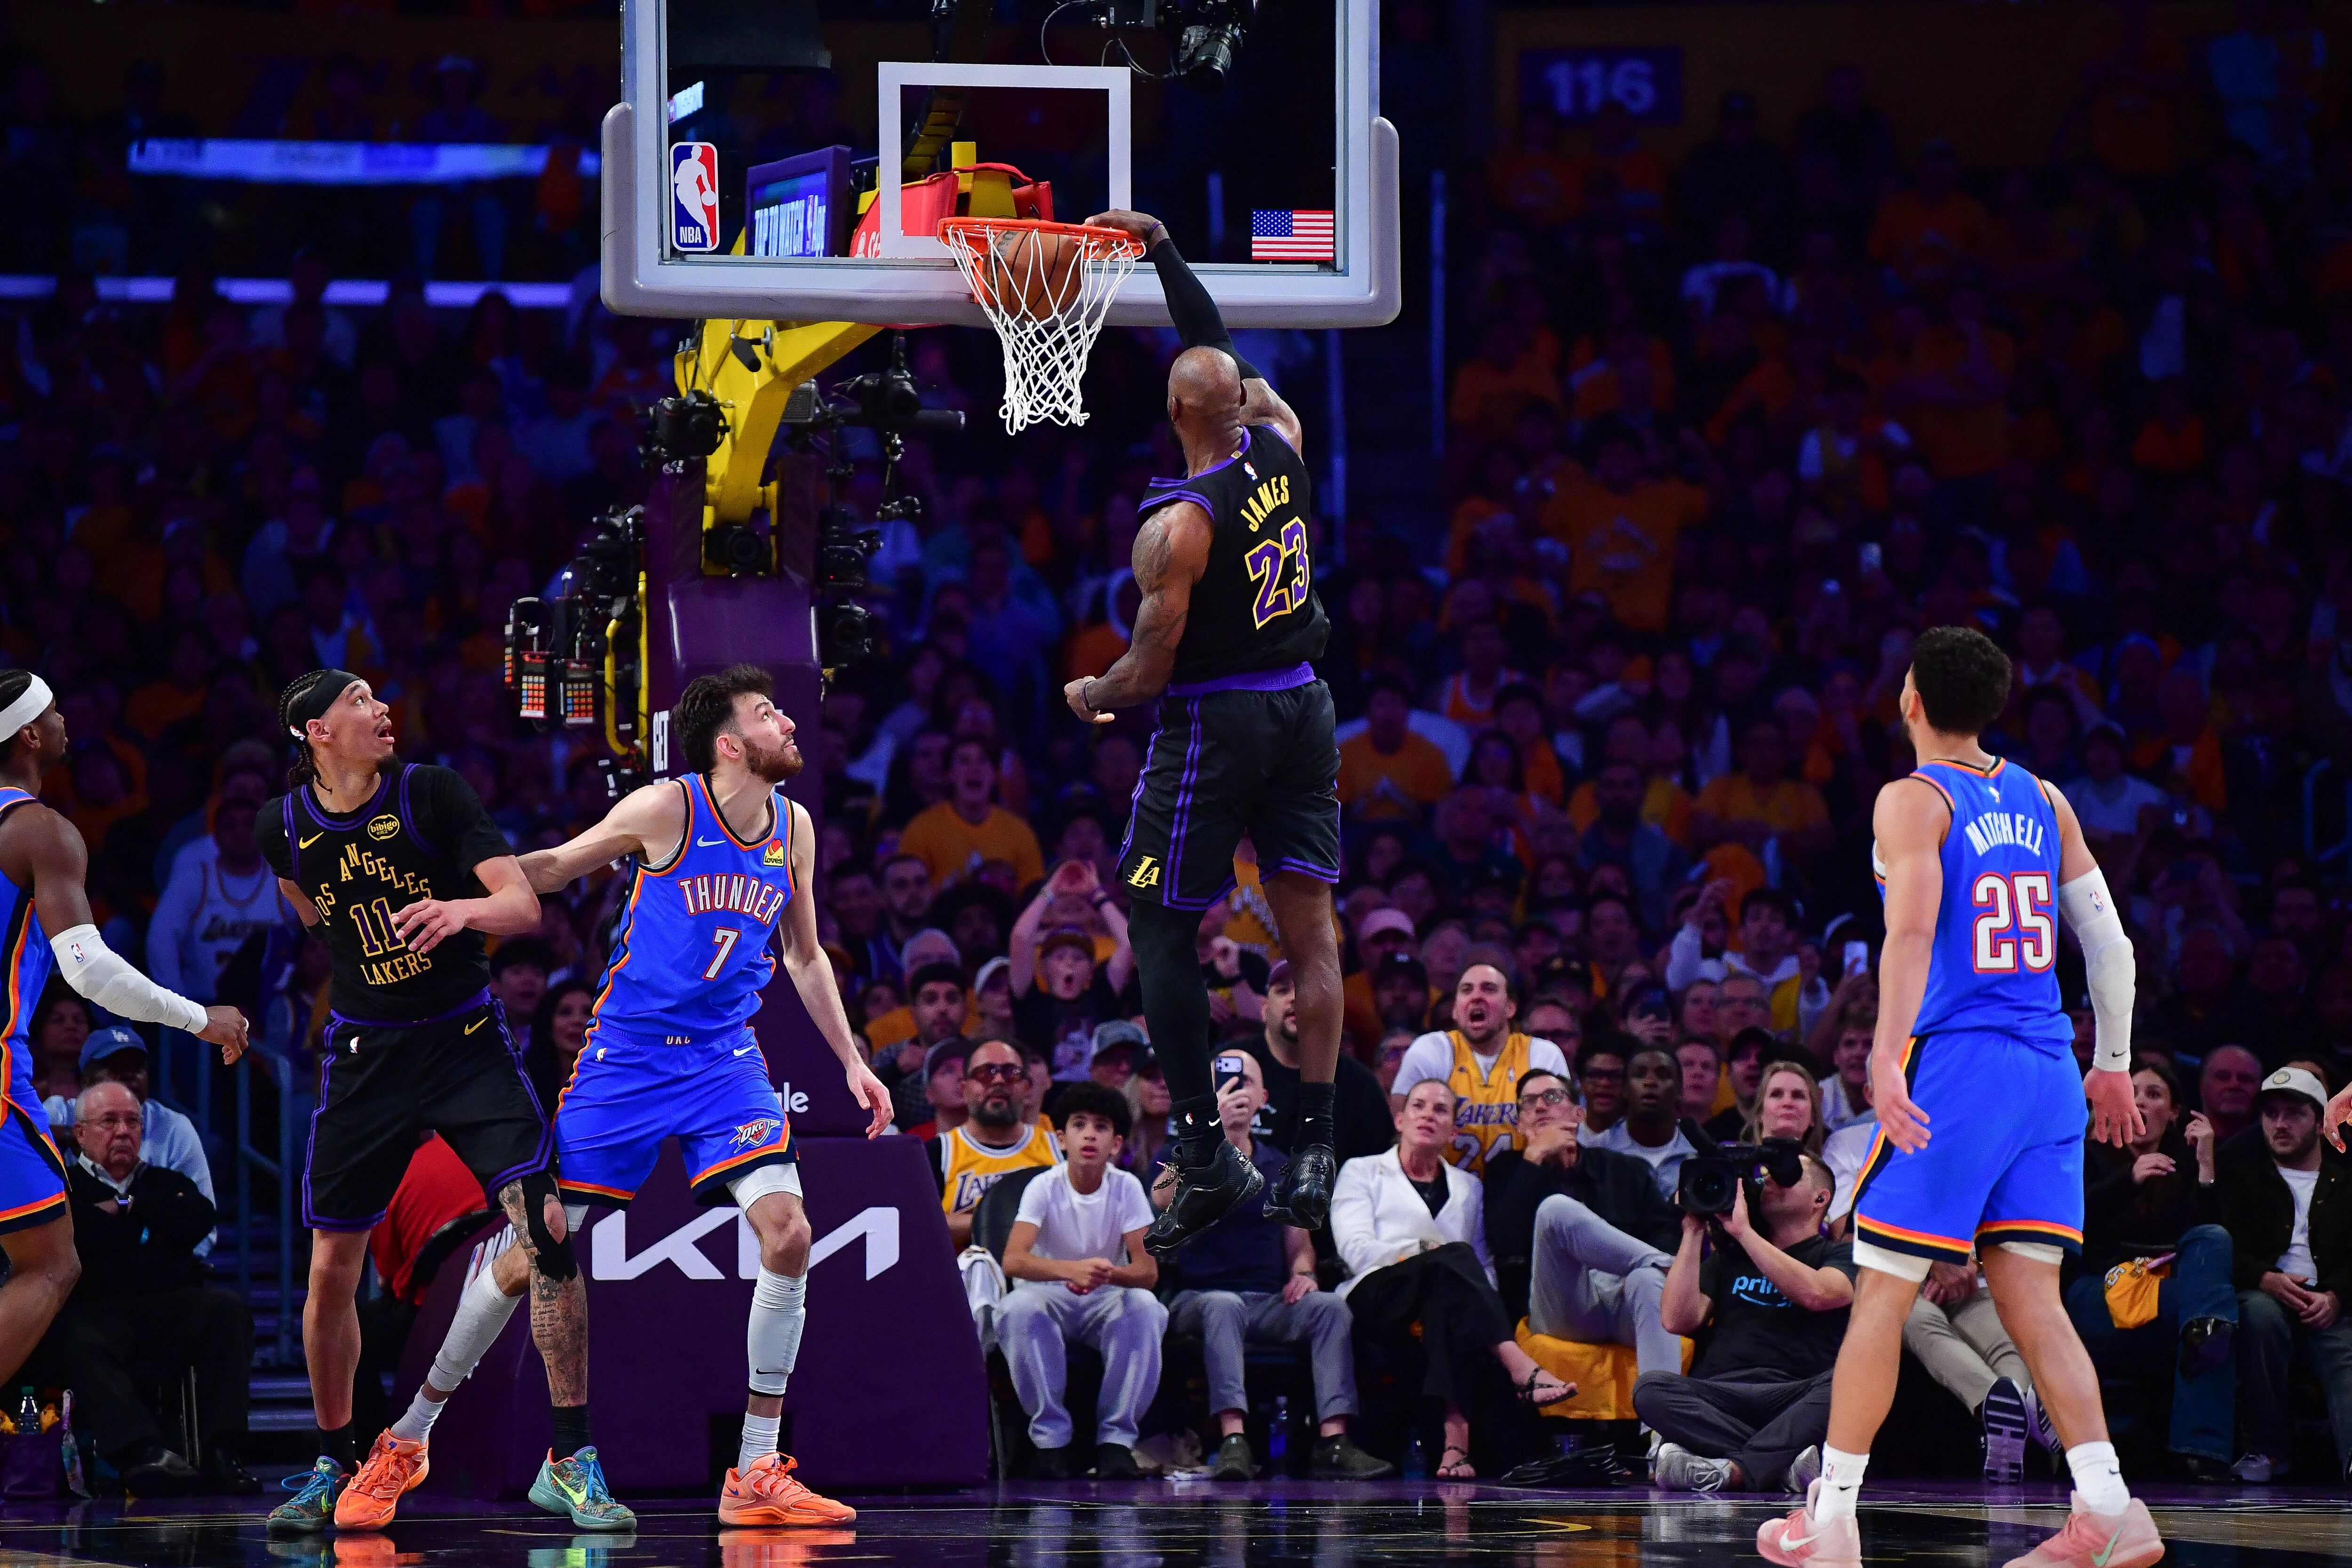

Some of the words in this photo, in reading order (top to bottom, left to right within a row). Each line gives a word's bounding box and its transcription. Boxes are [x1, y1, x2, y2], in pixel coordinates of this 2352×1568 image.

[1544, 60, 1656, 114] 116
[680, 226, 702, 244] NBA
[1240, 475, 1290, 533] JAMES
[1244, 516, 1310, 630] 23
[370, 821, 397, 833] bibigo
[1964, 810, 2044, 857] MITCHELL
[340, 843, 432, 900] ANGELES
[1127, 855, 1161, 888] LA
[349, 897, 406, 957] 11
[678, 873, 786, 928] THUNDER
[1972, 871, 2054, 974] 25
[360, 950, 432, 985] LAKERS
[701, 926, 742, 981] 7
[773, 1082, 809, 1113] le
[740, 1121, 763, 1143] OKC
